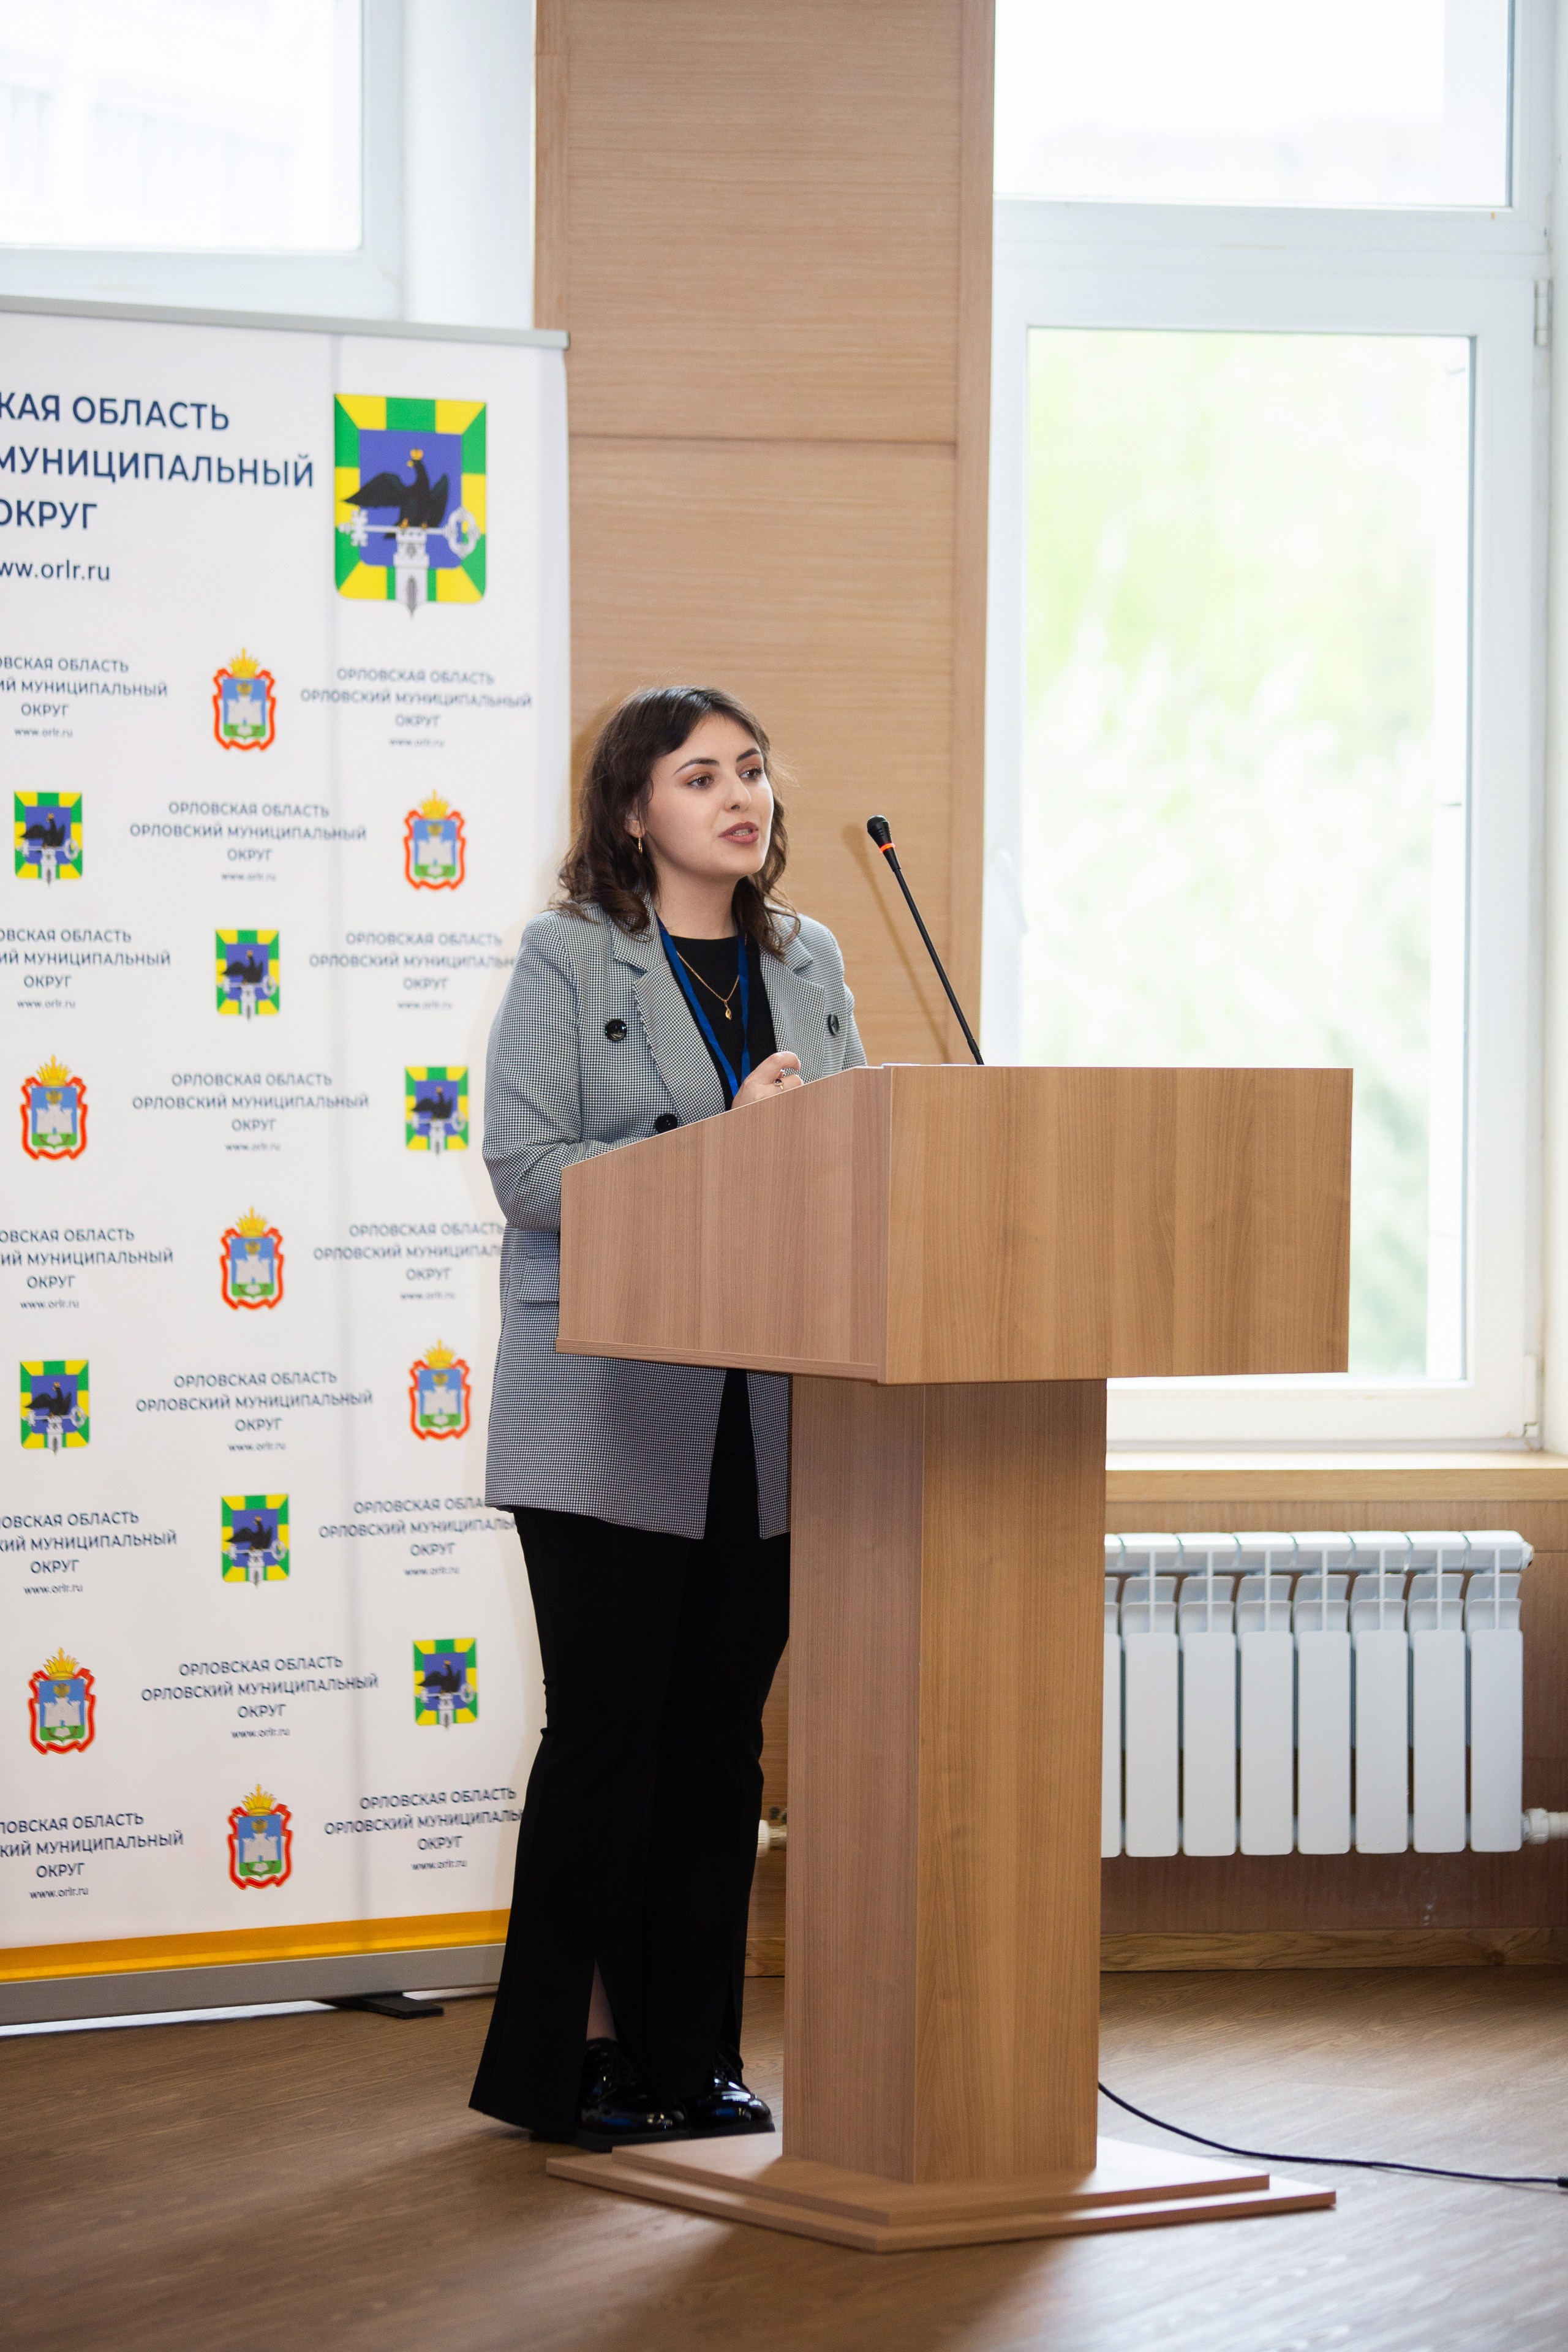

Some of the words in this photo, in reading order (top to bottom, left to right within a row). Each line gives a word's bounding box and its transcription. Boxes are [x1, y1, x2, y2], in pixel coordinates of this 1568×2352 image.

[72, 394, 230, 432] ОБЛАСТЬ
[0, 655, 53, 671] ВСКАЯ
[58, 657, 129, 673] ОБЛАСТЬ
[336, 667, 426, 682] ОРЛОВСКАЯ
[429, 670, 495, 685] ОБЛАСТЬ
[21, 680, 168, 697] МУНИЦИПАЛЬНЫЙ
[300, 688, 391, 704] ОРЛОВСКИЙ
[395, 692, 532, 708] МУНИЦИПАЛЬНЫЙ
[20, 703, 69, 717] ОКРУГ
[395, 714, 440, 727] ОКРУГ
[14, 728, 73, 737] www.orlr.ru
[168, 801, 258, 816] ОРЛОВСКАЯ
[262, 803, 330, 818] ОБЛАСТЬ
[129, 822, 223, 838] ОРЛОВСКИЙ
[227, 826, 367, 841] МУНИЦИПАЛЬНЫЙ
[227, 848, 272, 861] ОКРУГ
[60, 929, 132, 943] ОБЛАСТЬ
[345, 932, 434, 946] ОРЛОВСКАЯ
[24, 950, 171, 968] МУНИЦИПАЛЬНЫЙ
[309, 952, 399, 968] ОРЛОВСКИЙ
[23, 974, 72, 989] ОКРУГ
[403, 977, 448, 990] ОКРУГ
[17, 999, 75, 1008] www.orlr.ru
[171, 1073, 262, 1087] ОРЛОВСКАЯ
[265, 1072, 333, 1087] ОБЛАСТЬ
[132, 1093, 227, 1110] ОРЛОВСКИЙ
[232, 1093, 369, 1110] МУНИЦИПАЛЬНЫЙ
[231, 1118, 276, 1132] ОКРУГ
[63, 1227, 135, 1243] ОБЛАСТЬ
[349, 1223, 437, 1237] ОРЛОВСКАЯ
[27, 1247, 173, 1267] МУНИЦИПАЛЬНЫЙ
[313, 1243, 402, 1261] ОРЛОВСКИЙ
[26, 1275, 76, 1289] ОКРУГ
[405, 1267, 451, 1281] ОКРУГ
[20, 1299, 79, 1309] www.orlr.ru
[173, 1373, 267, 1389] ОРЛОВСКАЯ
[270, 1371, 337, 1385] ОБЛАСТЬ
[135, 1393, 231, 1412] ОРЛОВСКИЙ
[235, 1390, 373, 1409] МУНИЦИПАЛЬНЫЙ
[235, 1417, 282, 1432] ОКРУГ
[352, 1498, 440, 1515] ОРЛОВСКАЯ
[444, 1496, 488, 1511] ОБЛА
[67, 1510, 140, 1526] ОБЛАСТЬ
[318, 1518, 406, 1539] ОРЛОВСКИЙ
[31, 1530, 177, 1551] МУНИЦИПАЛЬНЫЙ
[410, 1542, 456, 1557] ОКРУГ
[29, 1559, 80, 1574] ОКРУГ
[23, 1583, 83, 1594] www.orlr.ru
[178, 1659, 270, 1676] ОРЛОВСКАЯ
[274, 1656, 344, 1672] ОБЛАСТЬ
[141, 1681, 233, 1702] ОРЛОВСКИЙ
[238, 1673, 379, 1696] МУНИЦИПАЛЬНЫЙ
[237, 1703, 287, 1719] ОКРУГ
[358, 1792, 447, 1811] ОРЛОВСКАЯ
[450, 1787, 517, 1804] ОБЛАСТЬ
[72, 1812, 145, 1829] ОБЛАСТЬ
[323, 1815, 414, 1837] ОРЛОВСКИЙ
[36, 1830, 184, 1855] МУНИЦИПАЛЬНЫЙ
[417, 1835, 464, 1851] ОКРУГ
[35, 1862, 85, 1879] ОКРУГ
[29, 1887, 89, 1899] www.orlr.ru
